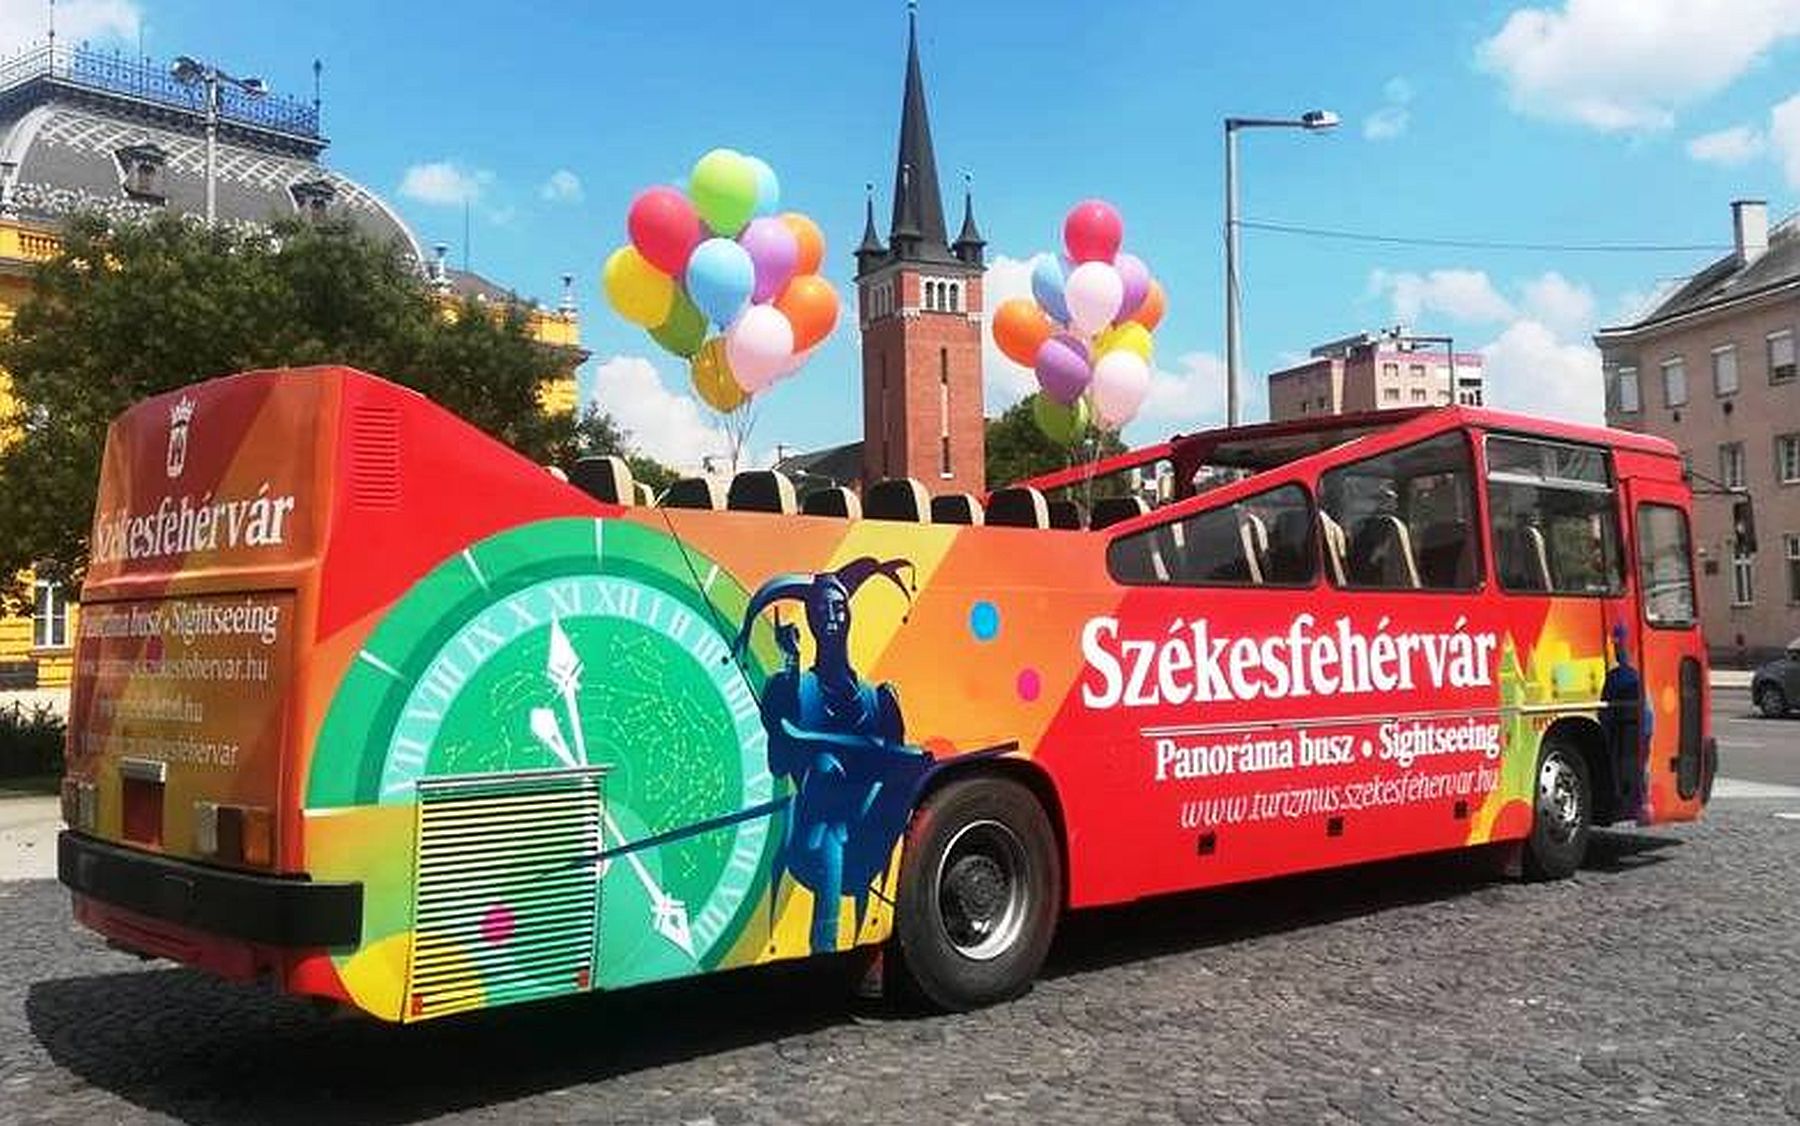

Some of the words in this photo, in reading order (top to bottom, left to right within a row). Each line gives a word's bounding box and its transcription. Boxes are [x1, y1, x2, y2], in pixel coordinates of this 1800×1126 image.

[172, 596, 279, 645] Sightseeing
[1081, 614, 1498, 710] Székesfehérvár
[1155, 731, 1294, 781] Panoráma
[1299, 730, 1355, 767] busz
[1378, 718, 1501, 769] Sightseeing
[1180, 764, 1499, 829] www.turizmus.szekesfehervar.hu
